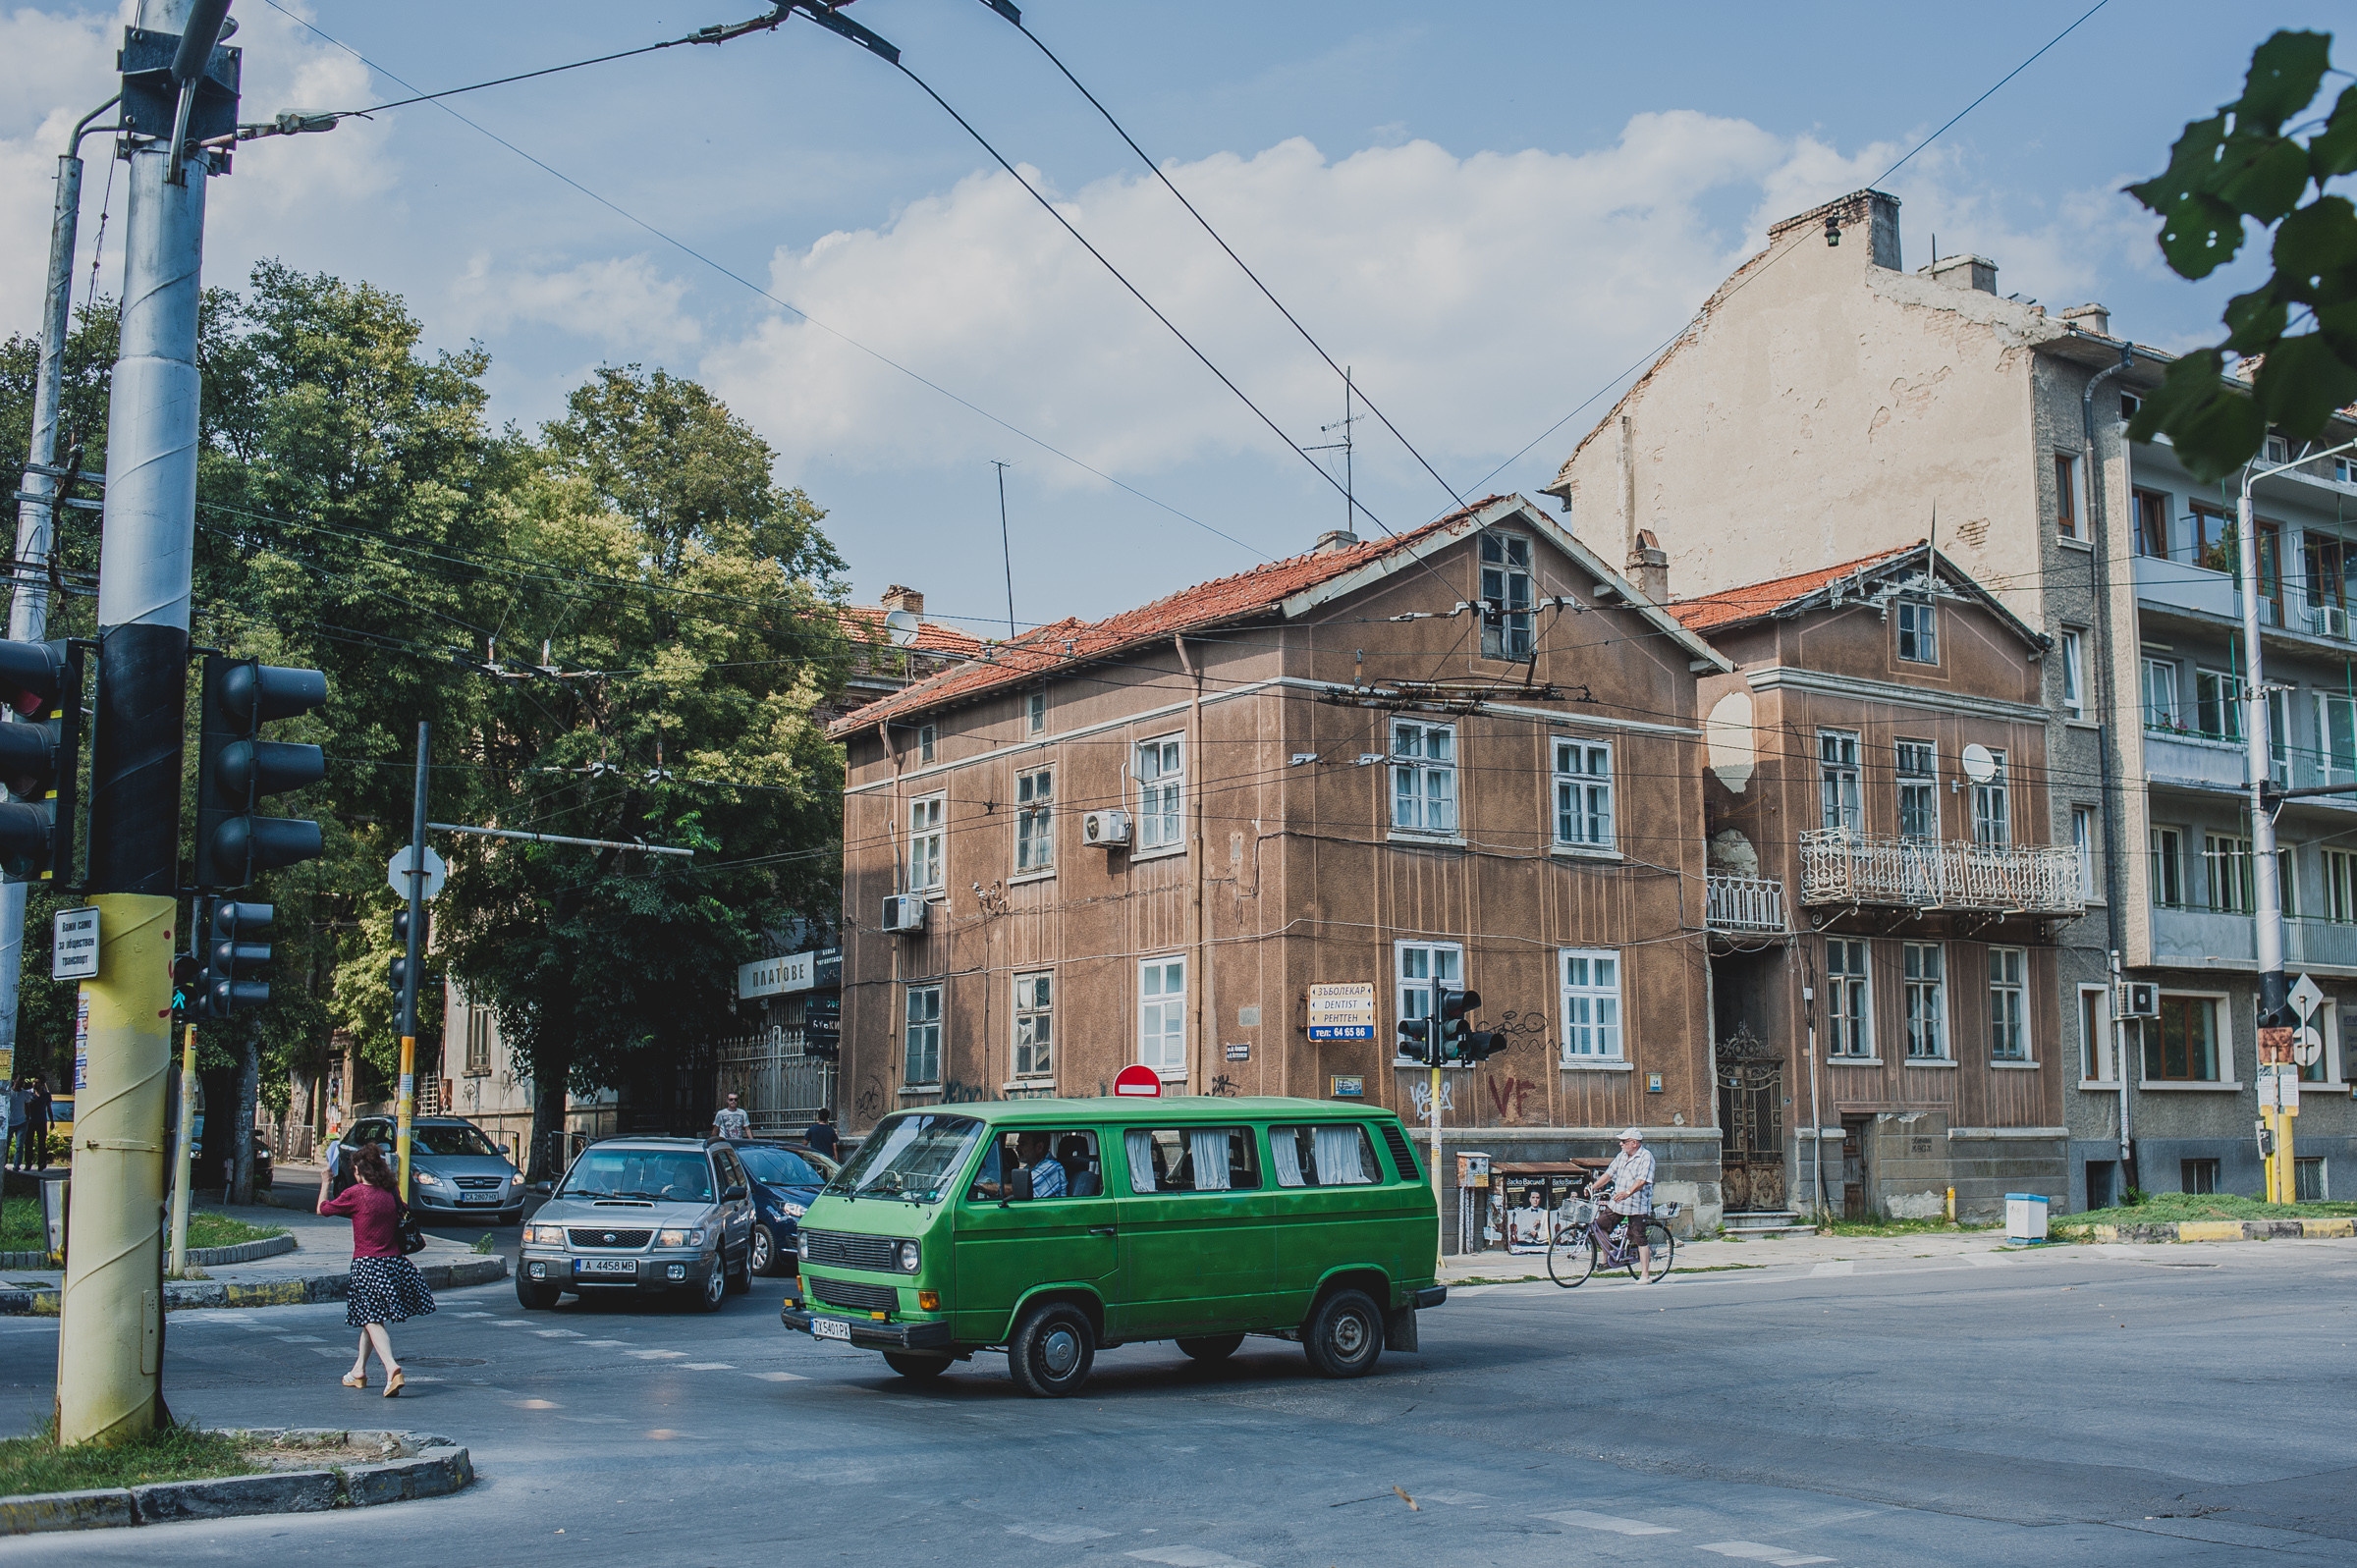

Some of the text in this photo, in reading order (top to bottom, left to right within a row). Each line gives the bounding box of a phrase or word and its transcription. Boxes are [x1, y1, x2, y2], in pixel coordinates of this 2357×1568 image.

[78, 920, 92, 931] само
[59, 941, 65, 951] за
[752, 963, 804, 988] ПЛАТОВЕ
[1318, 987, 1366, 997] ЗЪБОЛЕКАР
[1325, 1000, 1357, 1009] DENTIST
[1324, 1013, 1358, 1023] РЕНТГЕН
